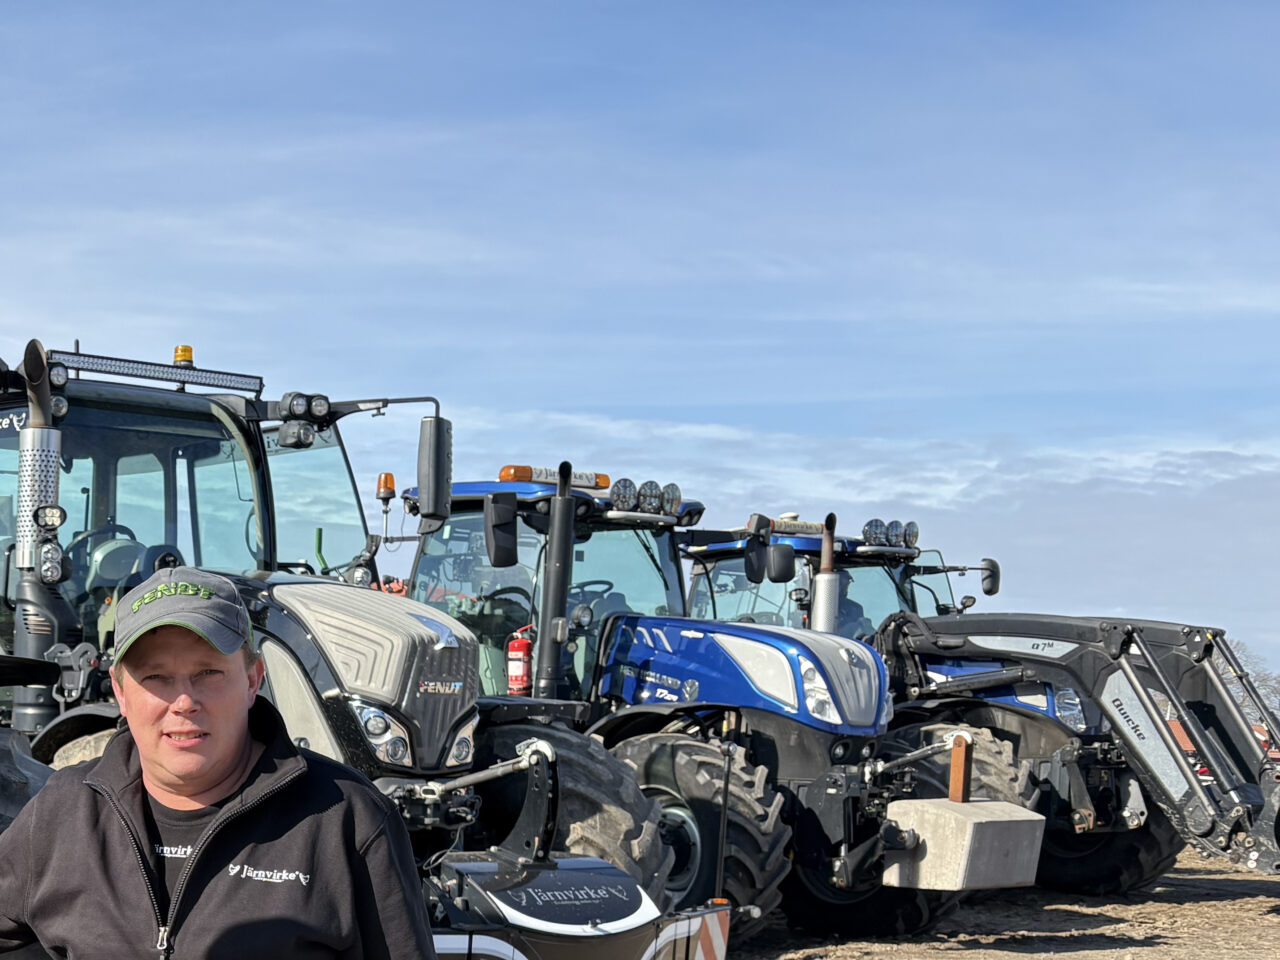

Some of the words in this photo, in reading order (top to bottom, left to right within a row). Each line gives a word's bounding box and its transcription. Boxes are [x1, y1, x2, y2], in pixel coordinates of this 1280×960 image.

[1112, 698, 1146, 740] Quicke
[241, 864, 296, 881] Järnvirke
[526, 885, 609, 905] Järnvirke
